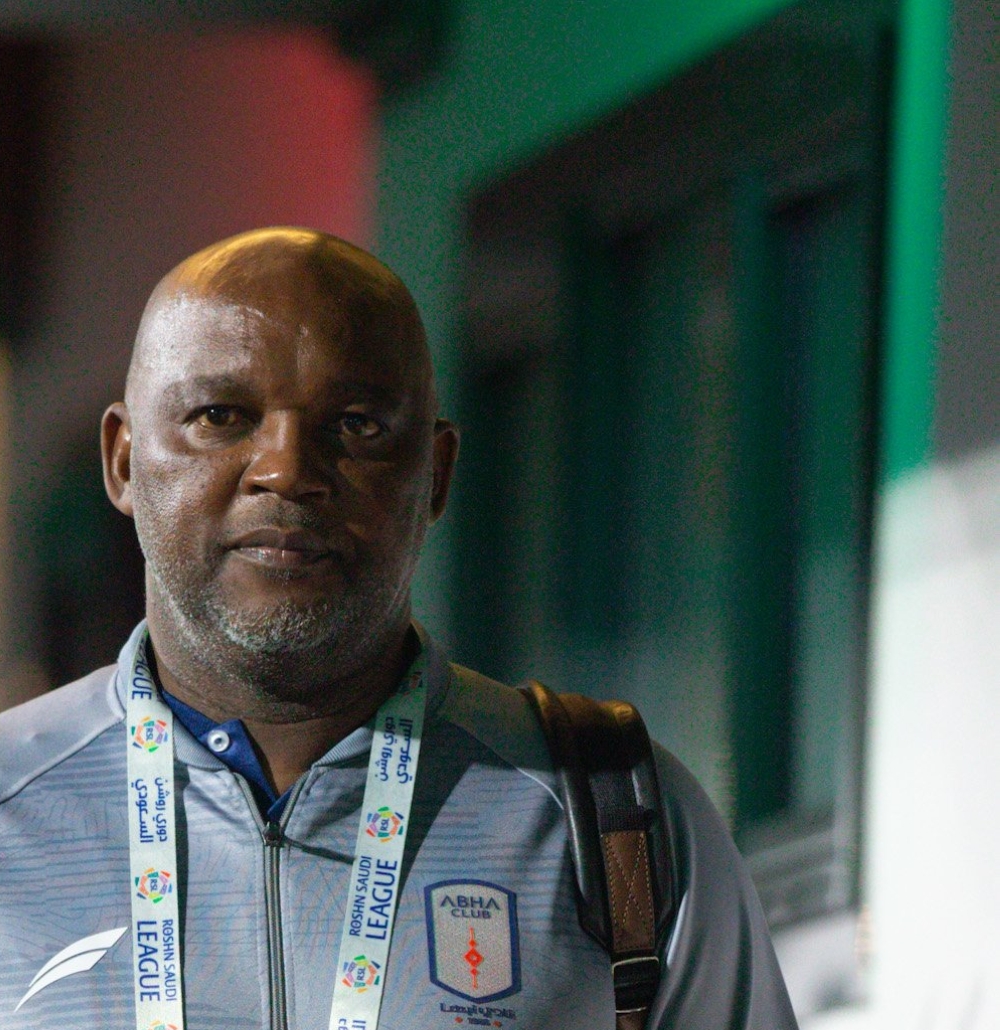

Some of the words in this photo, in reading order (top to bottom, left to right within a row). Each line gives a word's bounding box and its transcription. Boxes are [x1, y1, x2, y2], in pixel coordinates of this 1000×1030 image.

[382, 717, 397, 746] دوري
[397, 719, 413, 784] السعودي
[131, 778, 154, 843] السعودي
[152, 813, 168, 842] دوري
[380, 818, 389, 831] RSL
[150, 878, 158, 892] RSL
[356, 856, 372, 893] SAUDI
[350, 894, 366, 937] ROSHN
[366, 858, 398, 941] LEAGUE
[440, 895, 501, 910] ABHA
[451, 909, 492, 919] CLUB
[162, 919, 175, 961] ROSHN
[137, 920, 160, 1002] LEAGUE
[357, 967, 365, 981] RSL
[164, 964, 177, 1001] SAUDI
